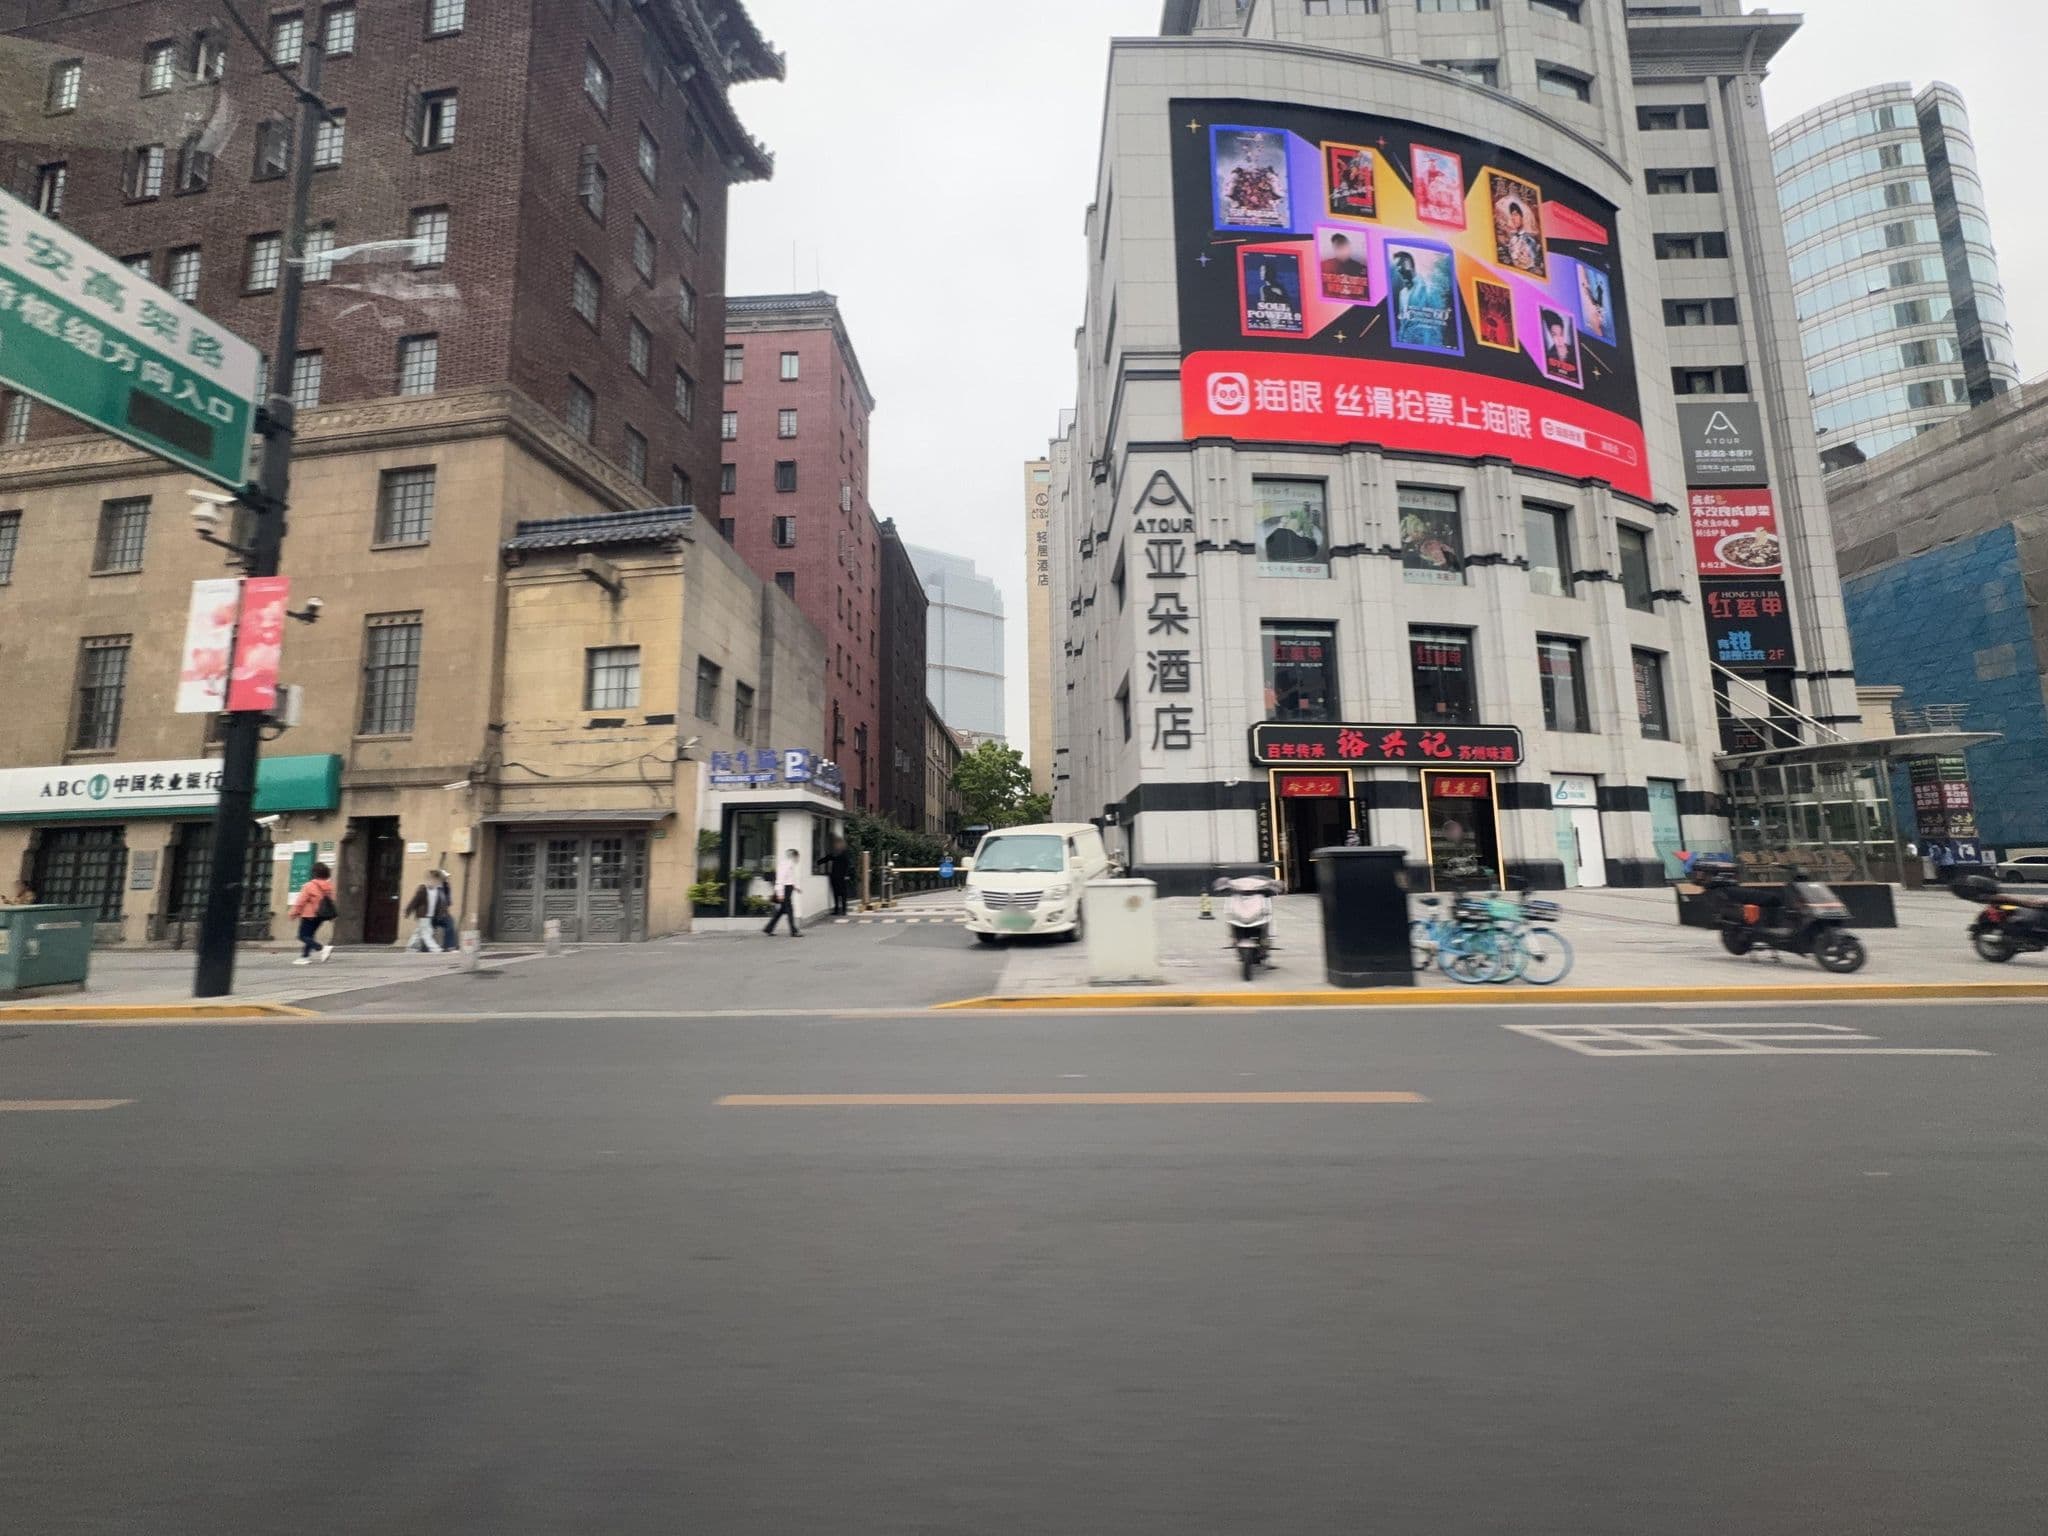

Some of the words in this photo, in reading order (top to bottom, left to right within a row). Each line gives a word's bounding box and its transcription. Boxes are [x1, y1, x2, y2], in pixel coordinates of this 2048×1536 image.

[1255, 378, 1323, 414] 猫眼
[1334, 383, 1531, 440] 丝滑抢票上猫眼
[1705, 437, 1740, 445] ATOUR
[1134, 517, 1193, 534] ATOUR
[1708, 592, 1783, 618] 红盔甲
[1145, 538, 1193, 751] 亚朵酒店
[1768, 649, 1785, 660] 2F
[1267, 743, 1326, 758] 百年传承
[1337, 729, 1453, 758] 裕兴记
[1457, 745, 1515, 761] 苏州味道
[40, 778, 87, 798] ABC
[113, 770, 224, 793] 中国农业银行
